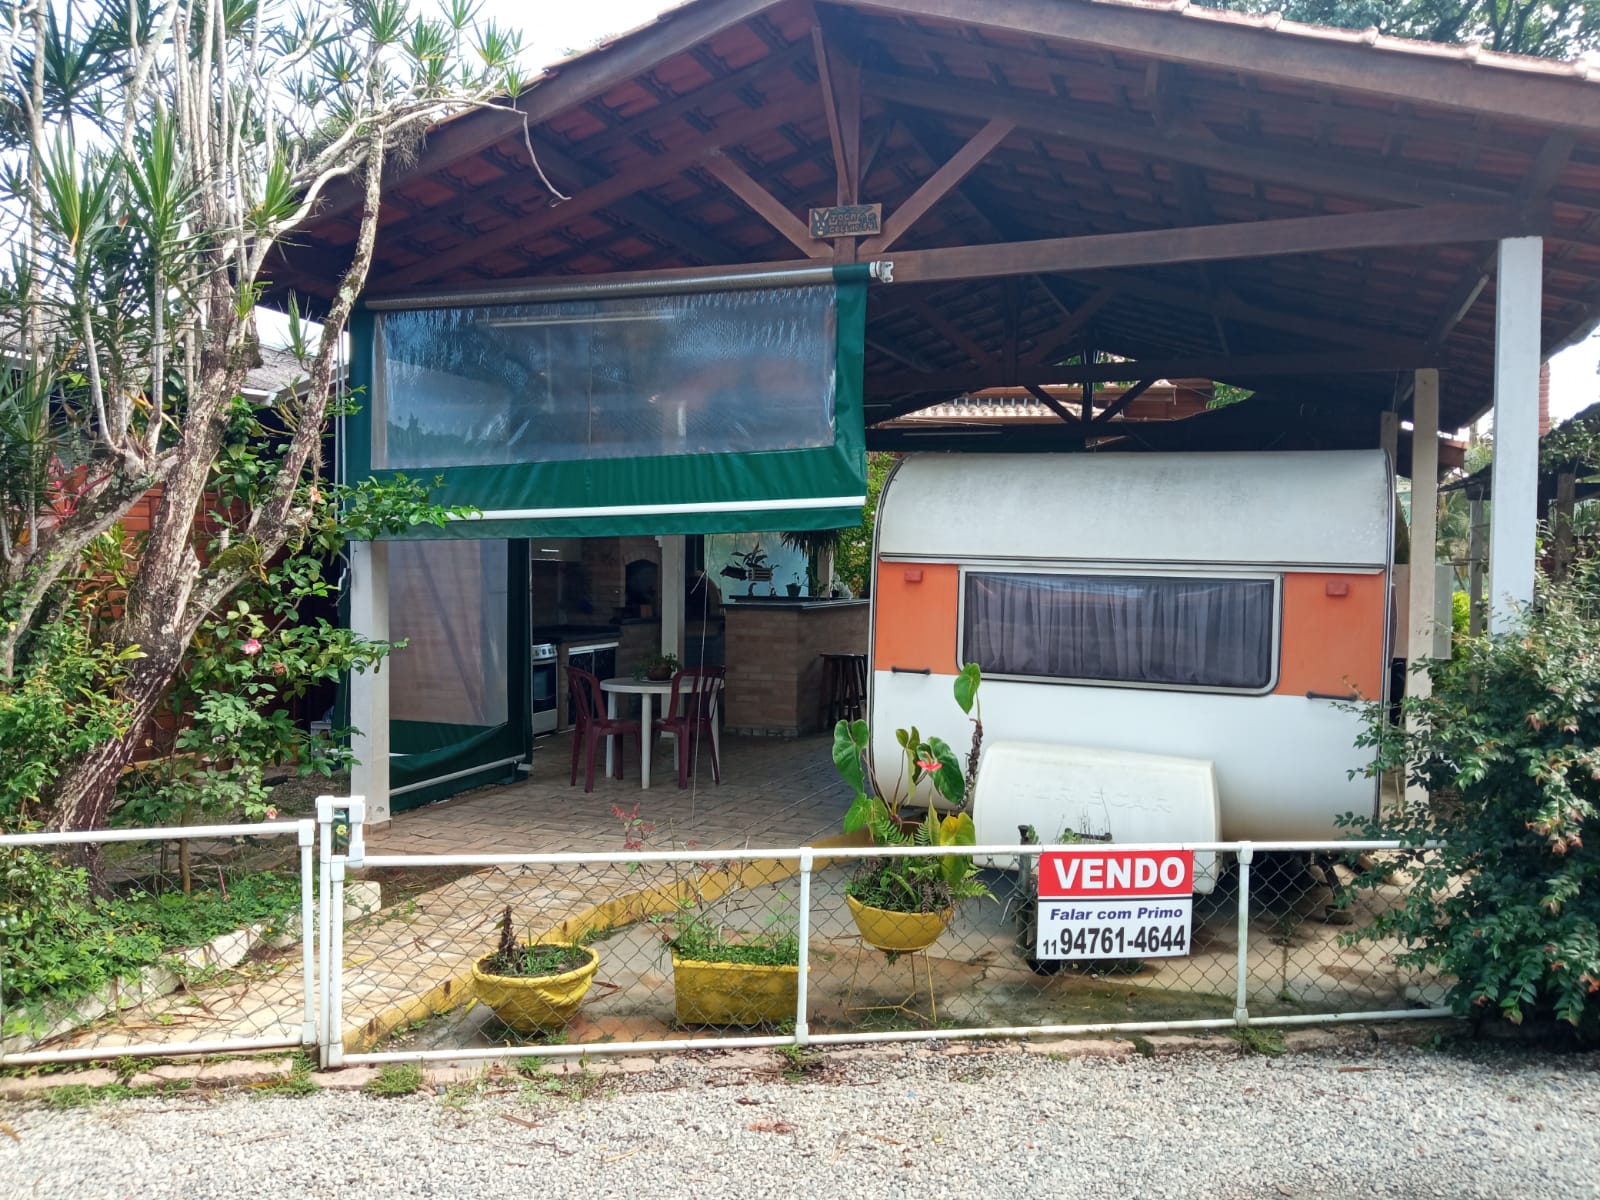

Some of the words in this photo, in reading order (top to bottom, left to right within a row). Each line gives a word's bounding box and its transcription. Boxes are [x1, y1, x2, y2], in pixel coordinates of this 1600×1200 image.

[1052, 857, 1186, 889] VENDO
[1050, 908, 1092, 921] Falar
[1097, 910, 1132, 920] com
[1137, 907, 1183, 919] Primo
[1043, 939, 1057, 955] 11
[1060, 925, 1186, 955] 94761-4644
